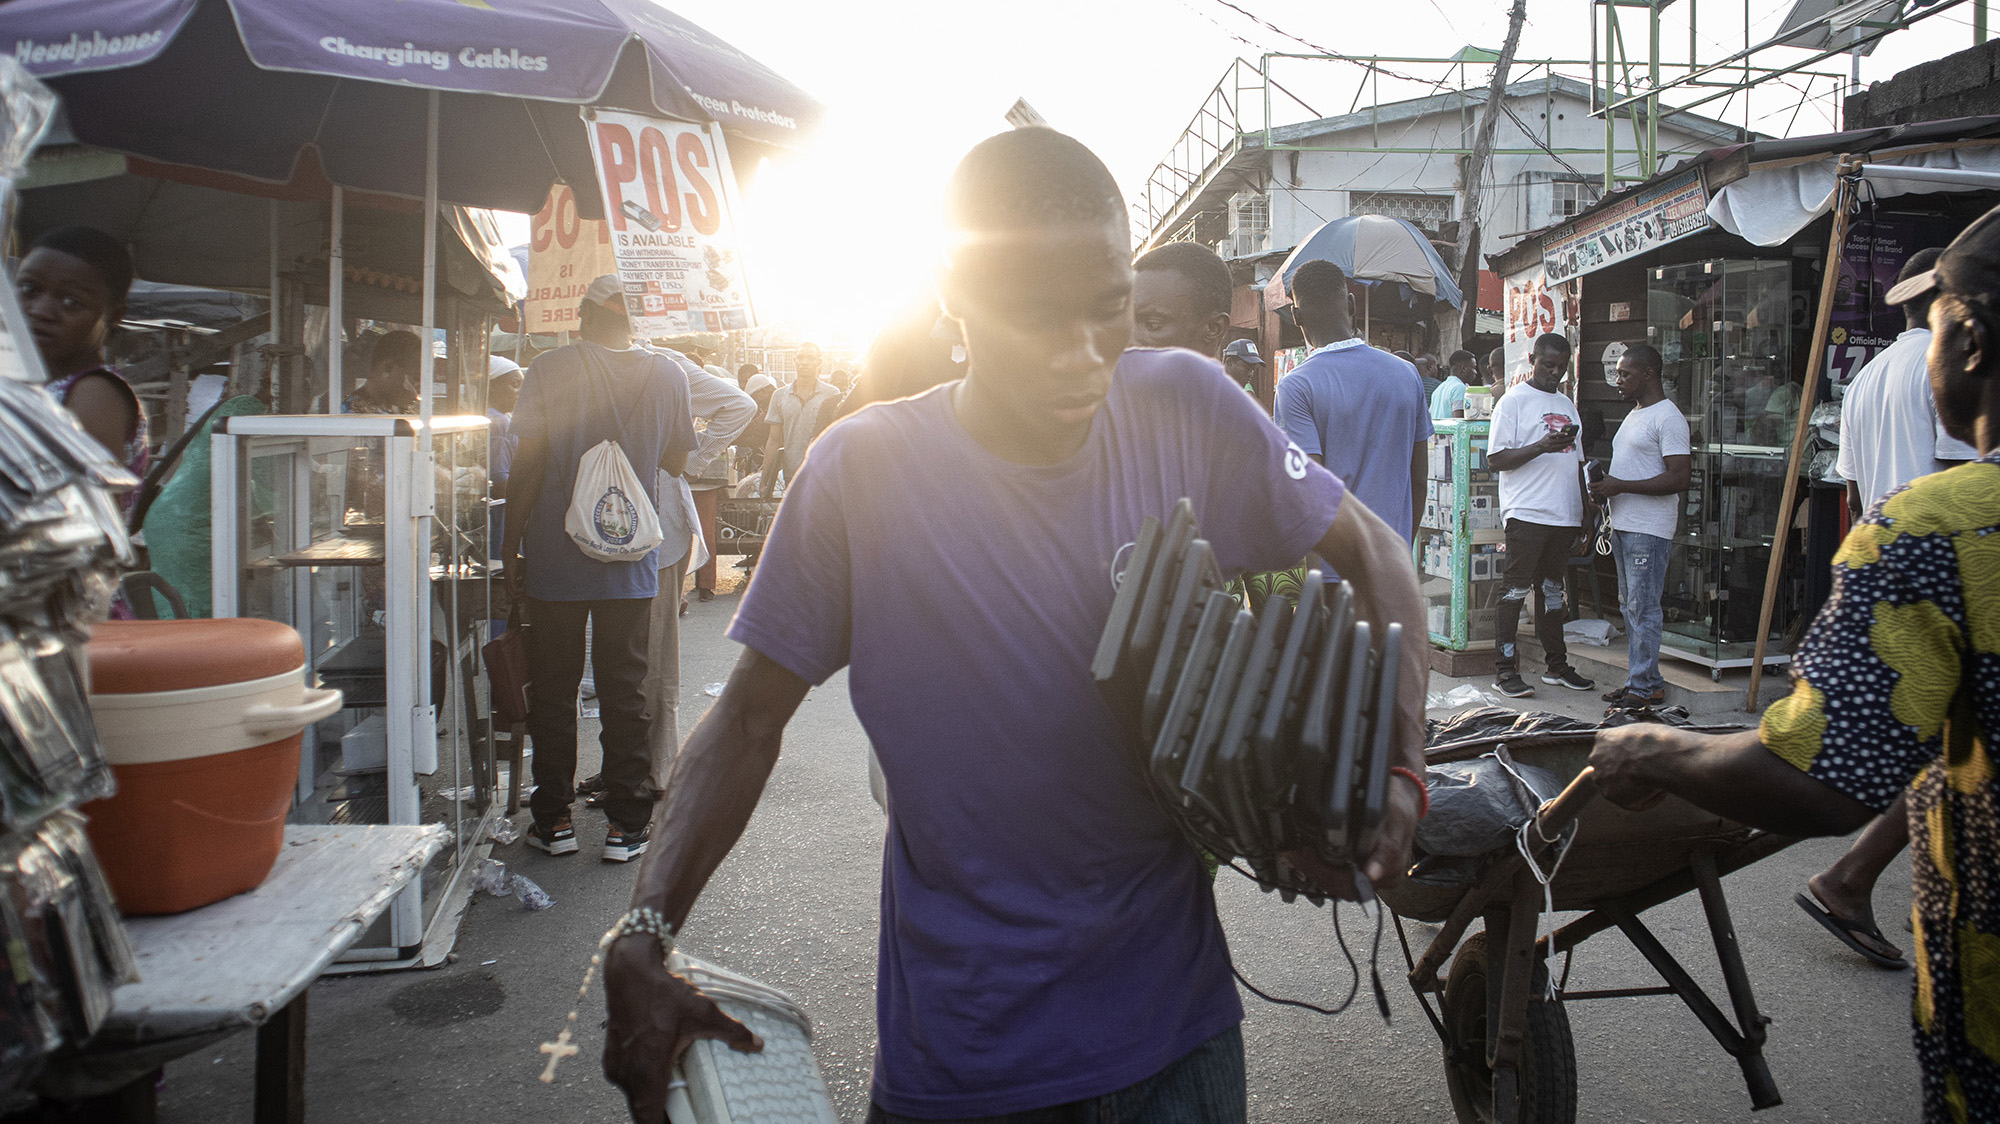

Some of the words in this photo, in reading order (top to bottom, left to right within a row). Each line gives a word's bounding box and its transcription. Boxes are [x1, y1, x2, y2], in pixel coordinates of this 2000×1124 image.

[16, 30, 162, 64] Headphones
[319, 36, 449, 71] Charging
[459, 47, 548, 72] Cables
[731, 99, 797, 130] Protectors
[596, 122, 720, 236] POS
[1652, 181, 1699, 206] ACCESSORIES
[618, 234, 629, 246] IS
[632, 234, 696, 248] AVAILABLE
[1543, 225, 1575, 246] EBENEZER
[1878, 237, 1897, 246] Smart
[636, 249, 676, 257] WITHDRAWAL
[621, 260, 641, 268] MONEY
[643, 261, 675, 269] TRANSFER
[623, 271, 654, 280] PAYMENT
[655, 272, 664, 280] OF
[666, 272, 685, 280] BILLS
[1509, 275, 1556, 343] POS
[1850, 336, 1876, 345] Official
